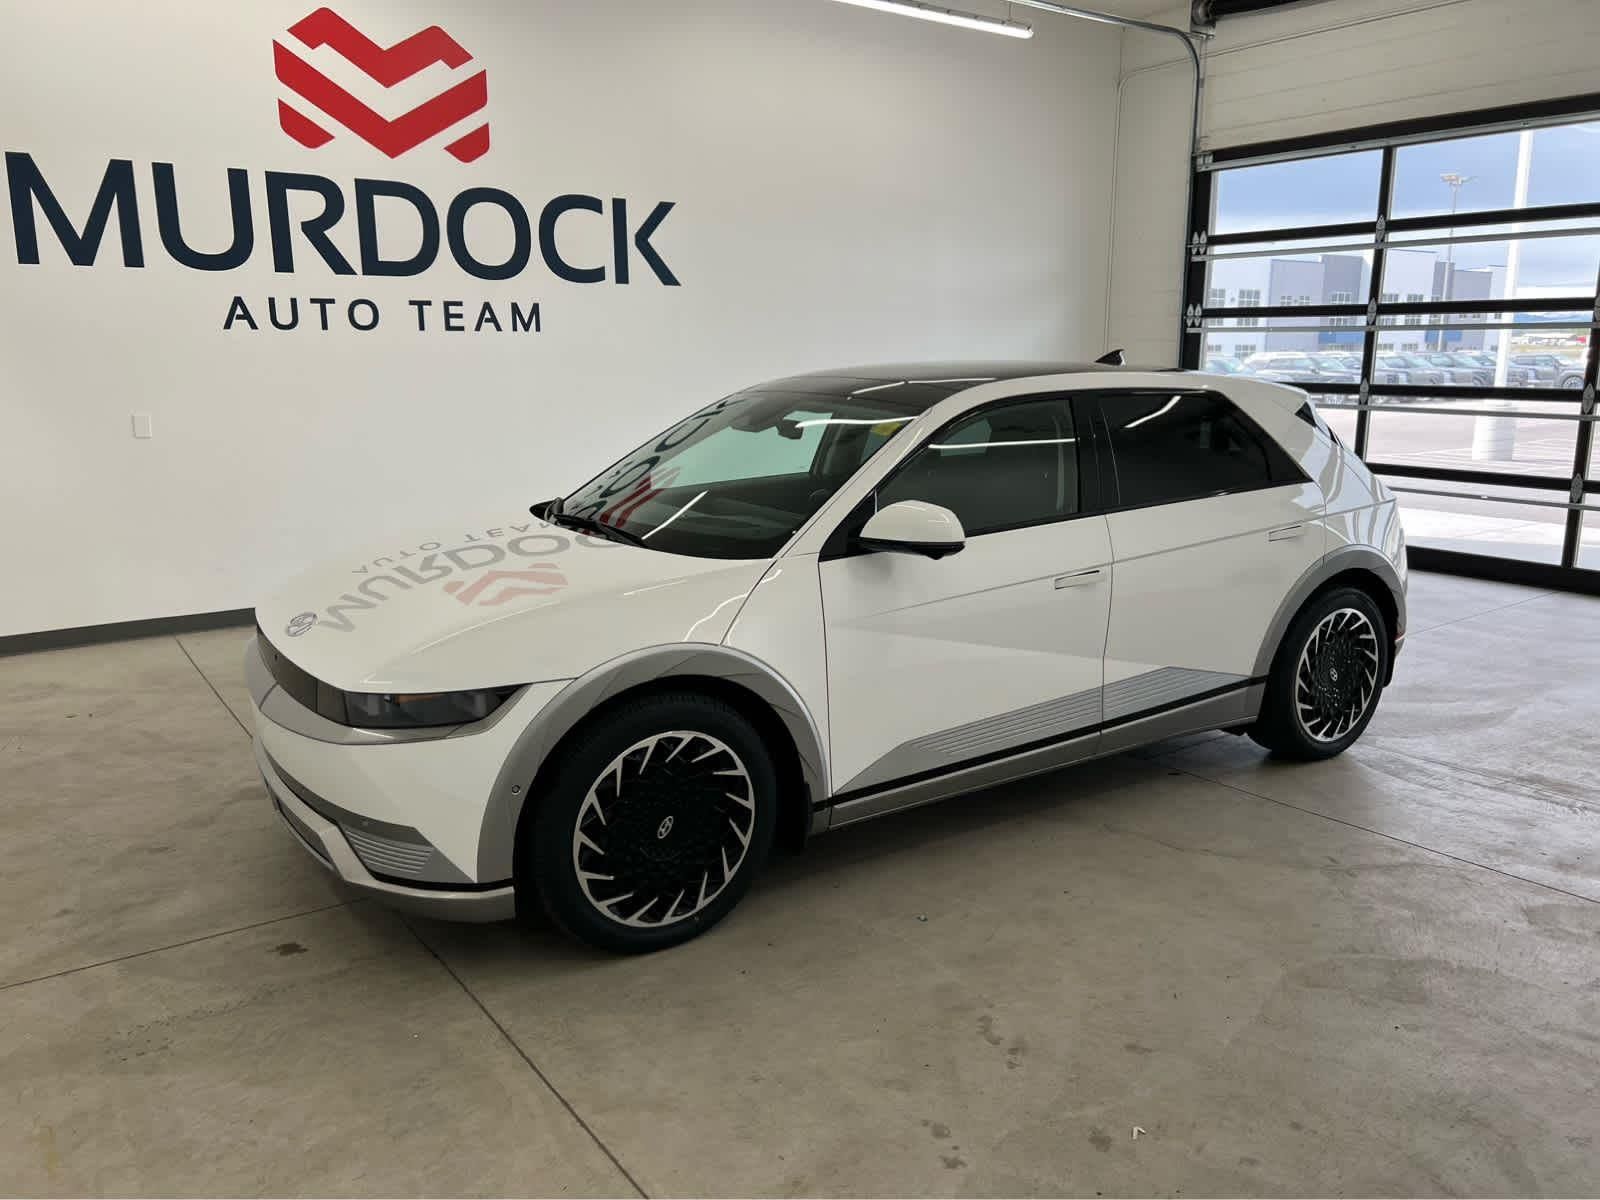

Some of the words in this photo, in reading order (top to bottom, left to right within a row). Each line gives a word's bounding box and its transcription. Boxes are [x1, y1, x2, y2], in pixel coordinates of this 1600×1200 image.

[5, 152, 681, 287] MURDOCK
[223, 296, 380, 331] AUTO
[409, 299, 541, 333] TEAM
